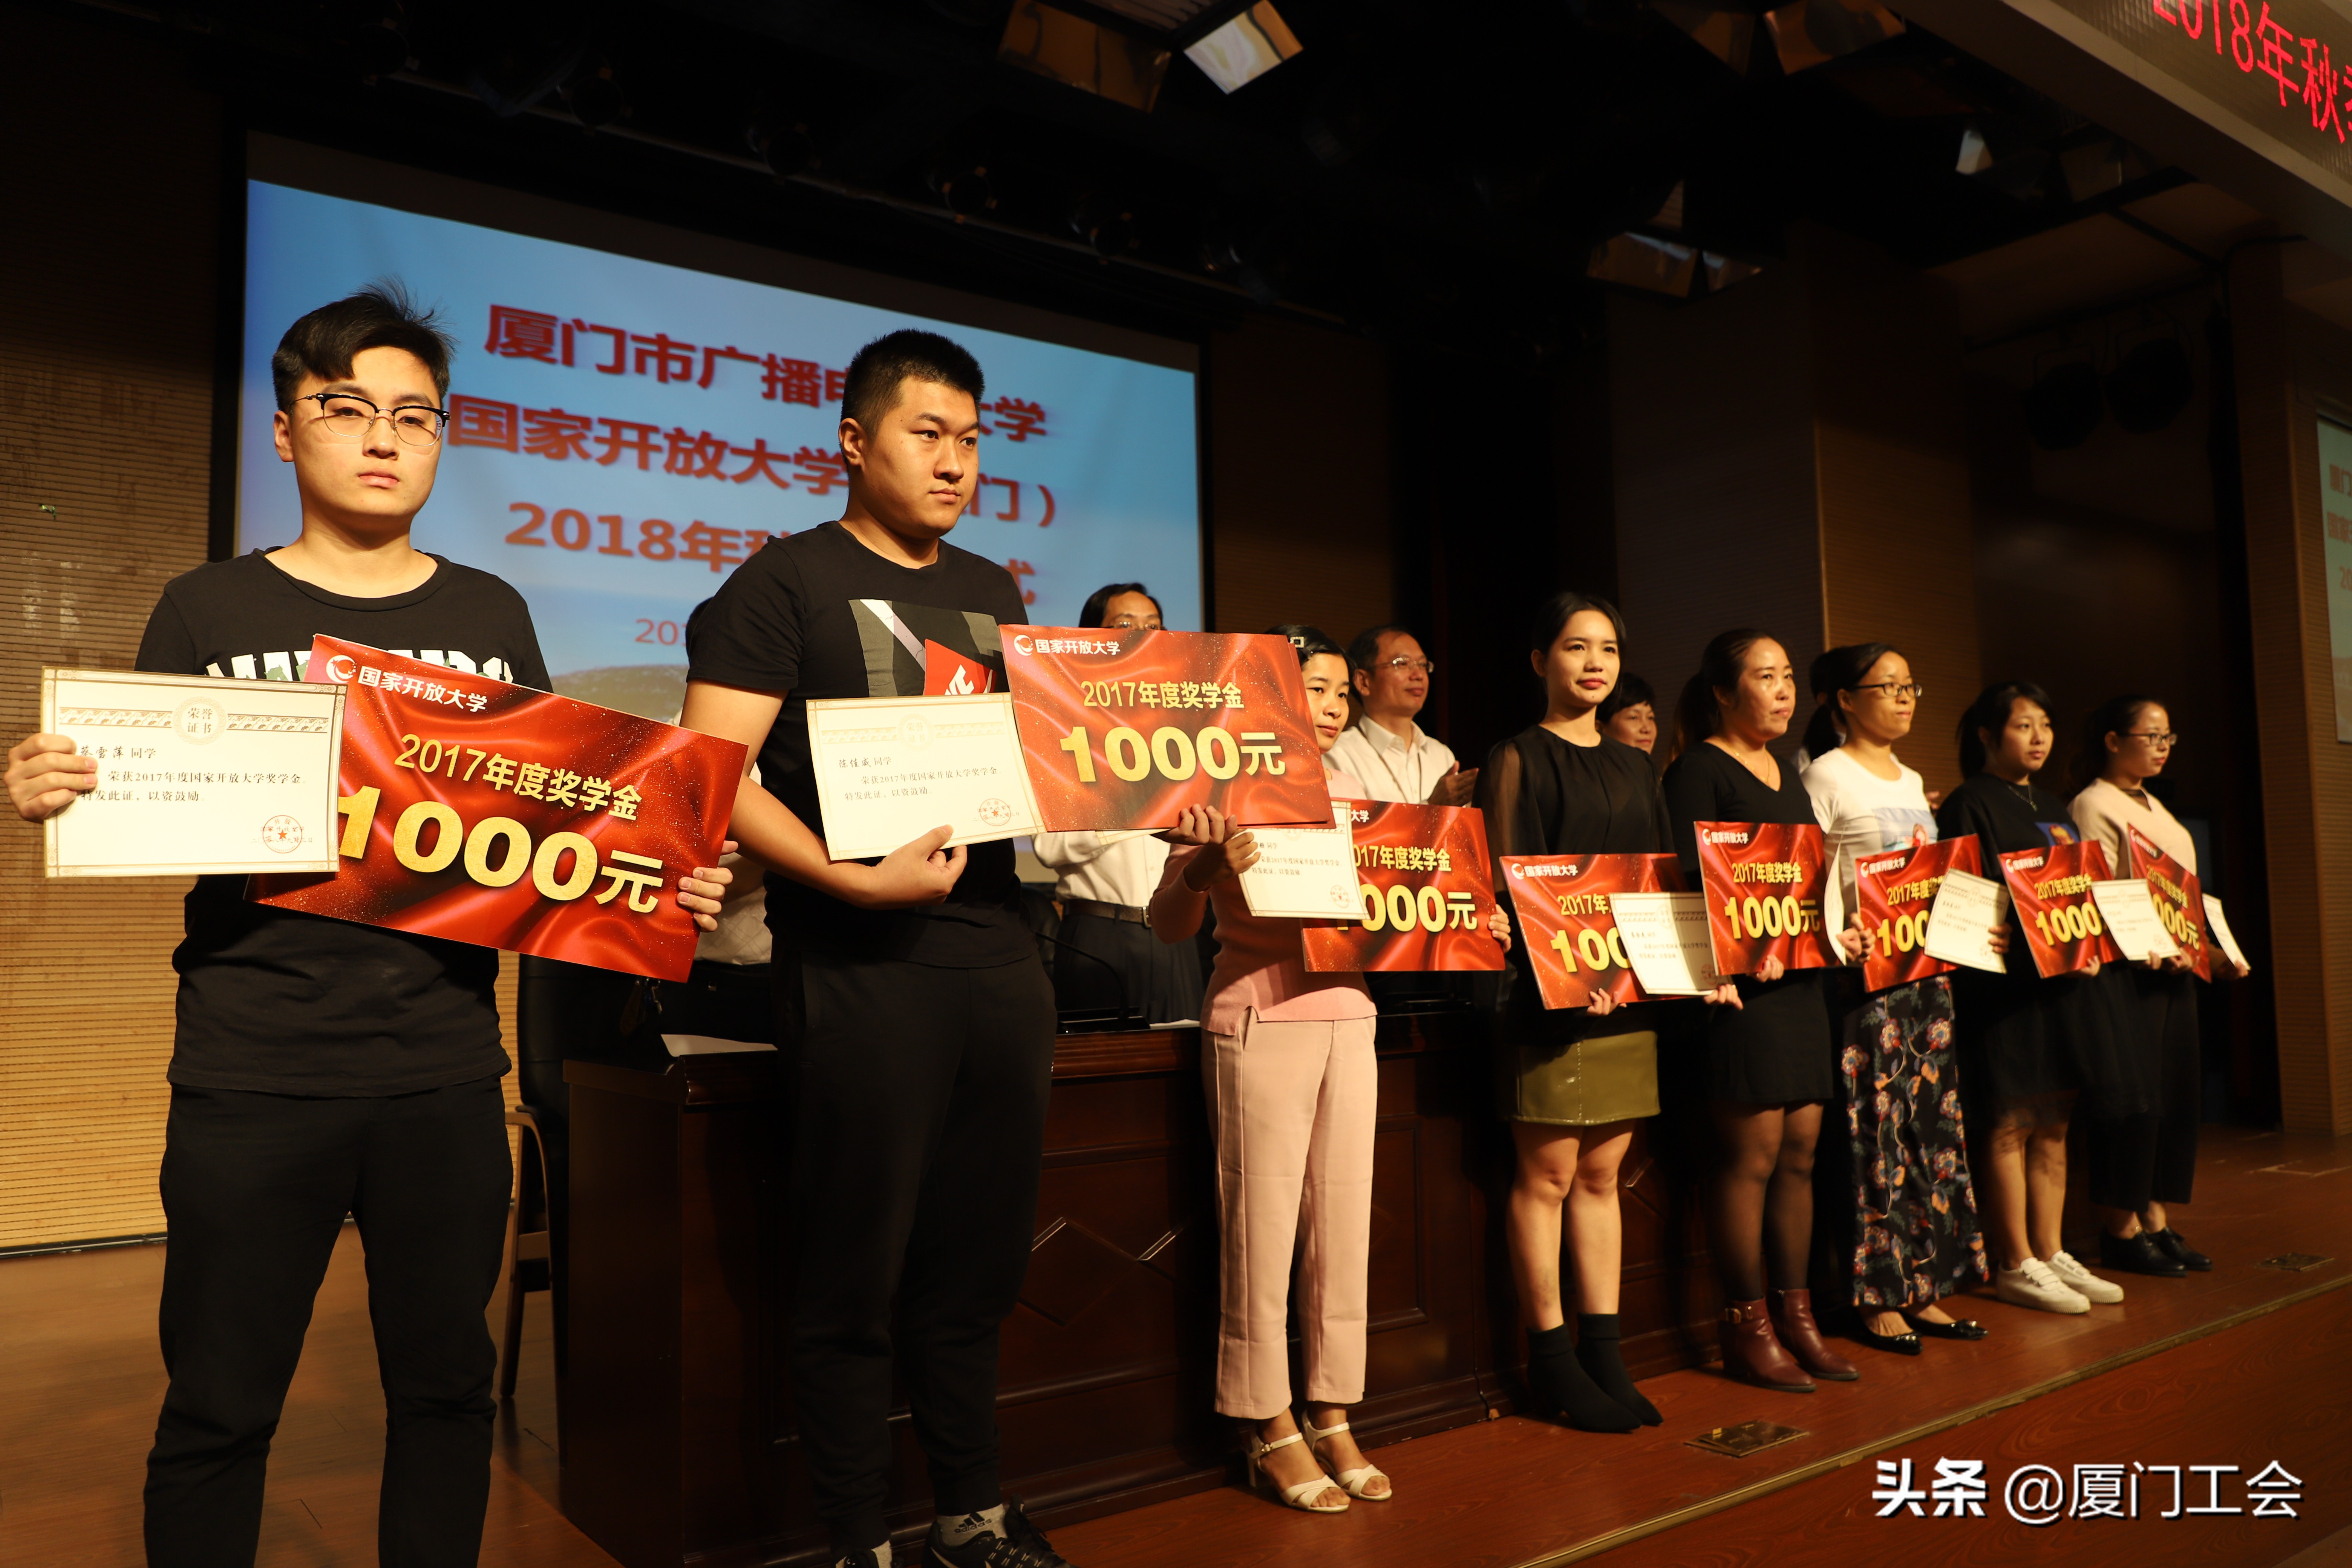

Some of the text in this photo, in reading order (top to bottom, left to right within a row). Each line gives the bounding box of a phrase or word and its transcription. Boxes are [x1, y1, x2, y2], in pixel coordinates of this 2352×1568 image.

[2153, 0, 2352, 144] 018年秋
[1035, 639, 1121, 655] 国家开放大学
[358, 665, 488, 713] 国家开放大学
[1081, 681, 1245, 709] 2017年度奖学金
[188, 707, 213, 720] 荣誉
[187, 722, 211, 733] 证书
[132, 747, 156, 759] 同学
[874, 756, 891, 766] 同学
[1060, 726, 1286, 782] 1000元
[108, 770, 306, 784] 荣获2017年度国家开放大学奖学金。
[394, 734, 643, 822] 2017年度奖学金
[338, 785, 664, 914] 1000元
[1732, 862, 1802, 883] 2017年度奖学金
[1337, 883, 1478, 933] 000元
[1557, 893, 1612, 915] 2017年
[1724, 895, 1820, 939] 1000元
[2035, 902, 2103, 946] 1000
[954, 1519, 992, 1533] adidas
